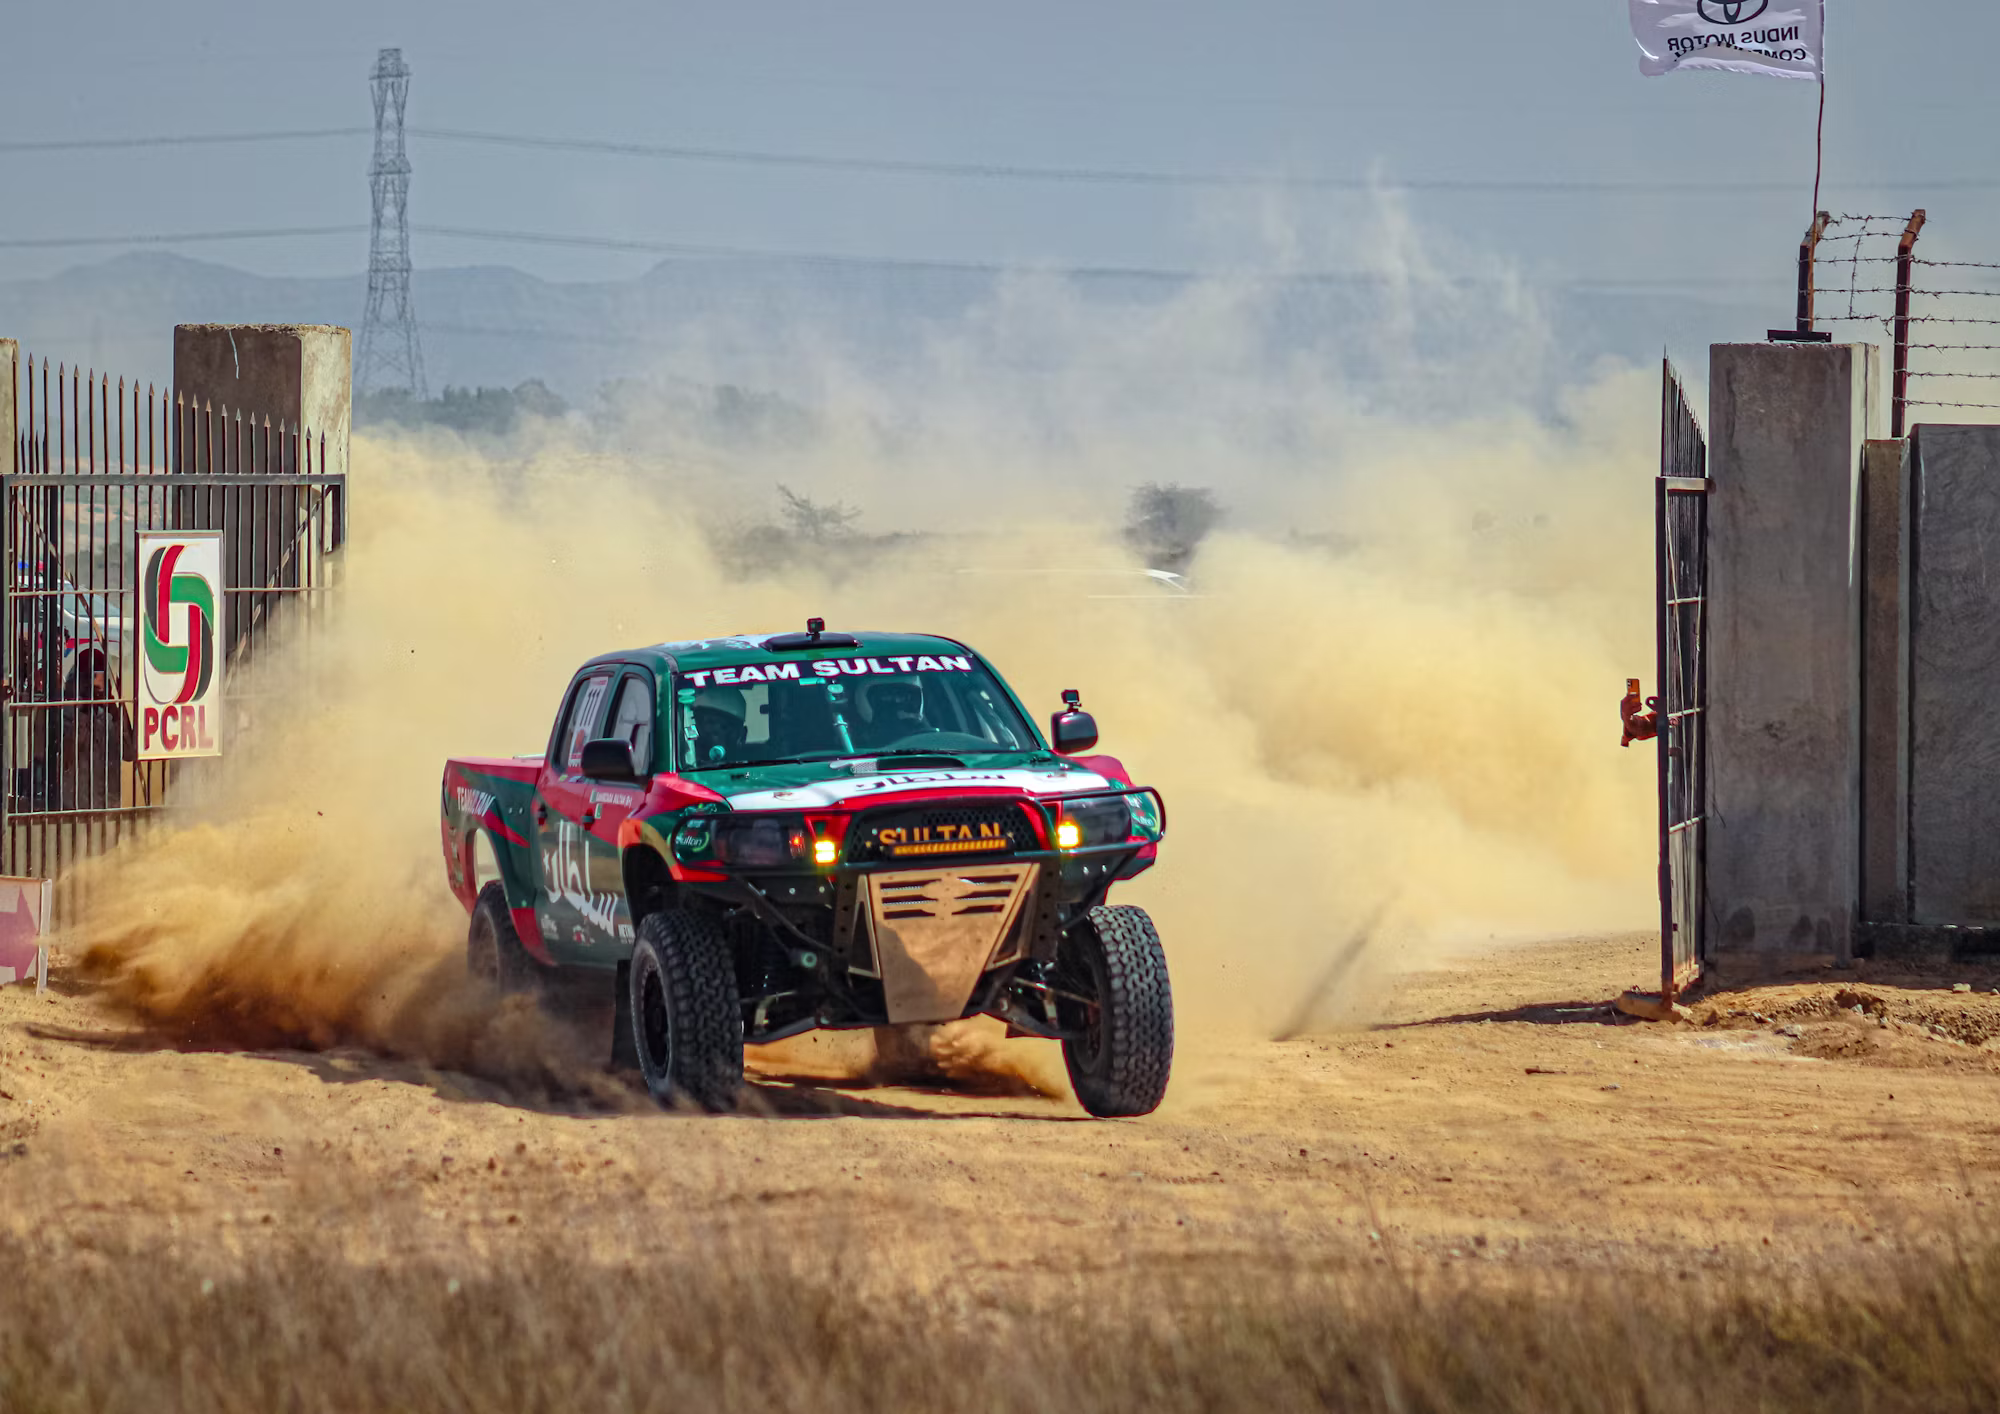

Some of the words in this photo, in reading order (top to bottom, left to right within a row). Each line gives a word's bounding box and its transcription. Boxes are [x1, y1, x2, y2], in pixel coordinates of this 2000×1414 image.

[684, 663, 801, 687] TEAM
[812, 656, 972, 677] SULTAN
[144, 704, 214, 752] PCRL
[879, 822, 1002, 845] SULTAN
